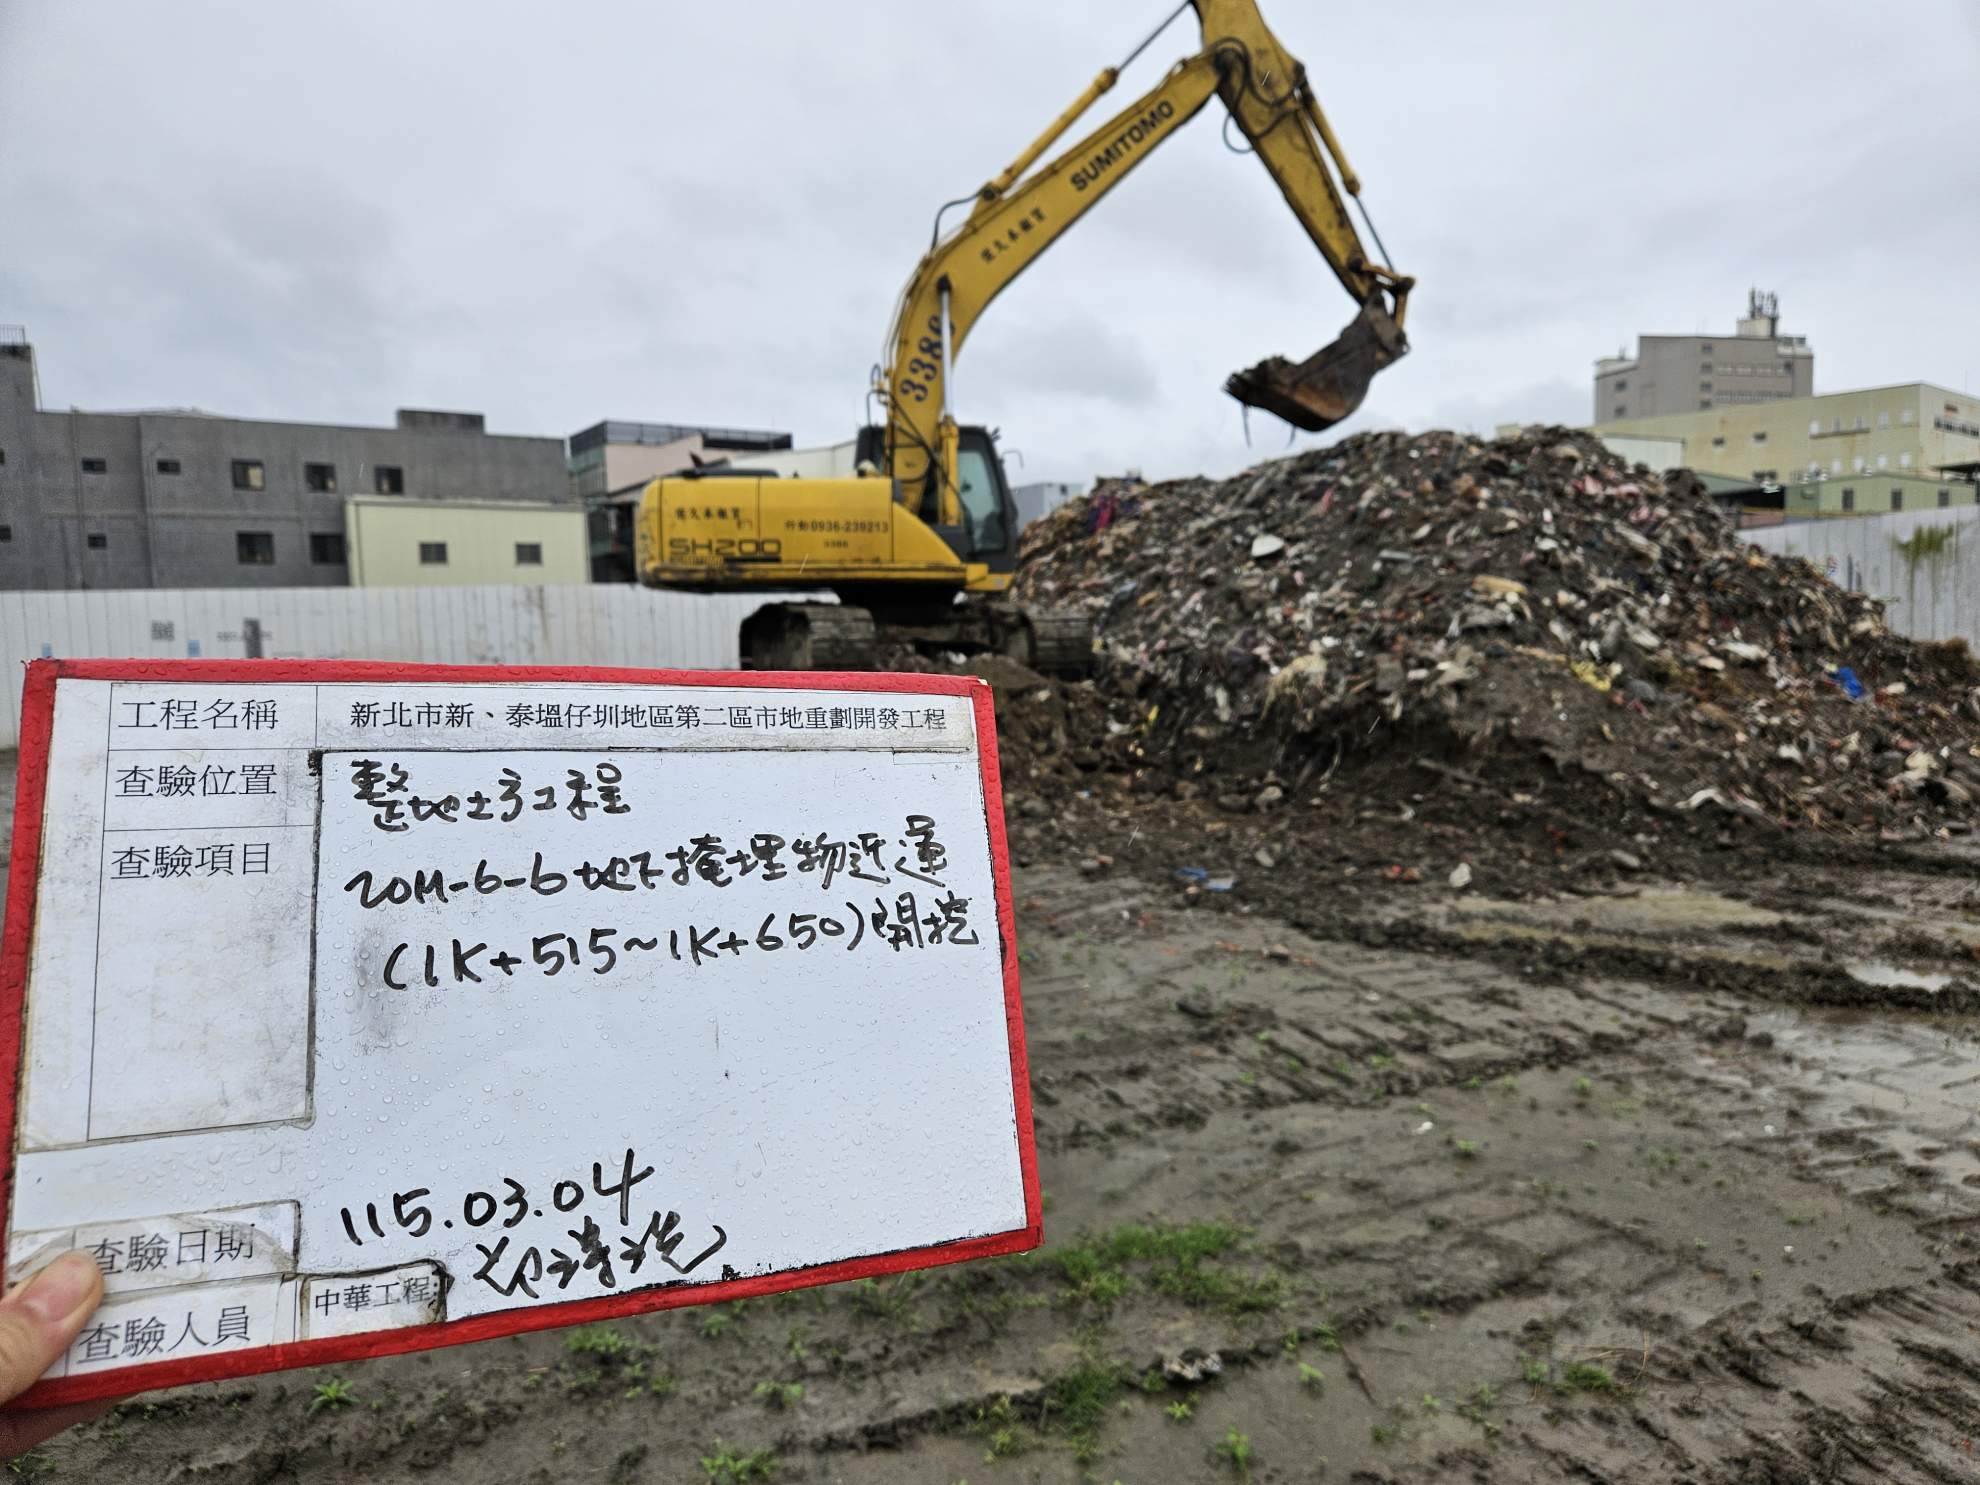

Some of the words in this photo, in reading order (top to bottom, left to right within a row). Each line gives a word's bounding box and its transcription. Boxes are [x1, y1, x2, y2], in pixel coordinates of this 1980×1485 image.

[1070, 100, 1174, 192] SUMITOMO
[669, 538, 782, 557] SH200
[119, 699, 278, 731] 工程名稱
[351, 702, 947, 730] 新北市新、泰塭仔圳地區第二區市地重劃開發工程
[115, 764, 277, 798] 查驗位置
[110, 842, 271, 880] 查驗項目
[340, 1148, 655, 1247] 115.03.04
[86, 1223, 255, 1275] 查驗日期
[77, 1304, 251, 1364] 查驗人員
